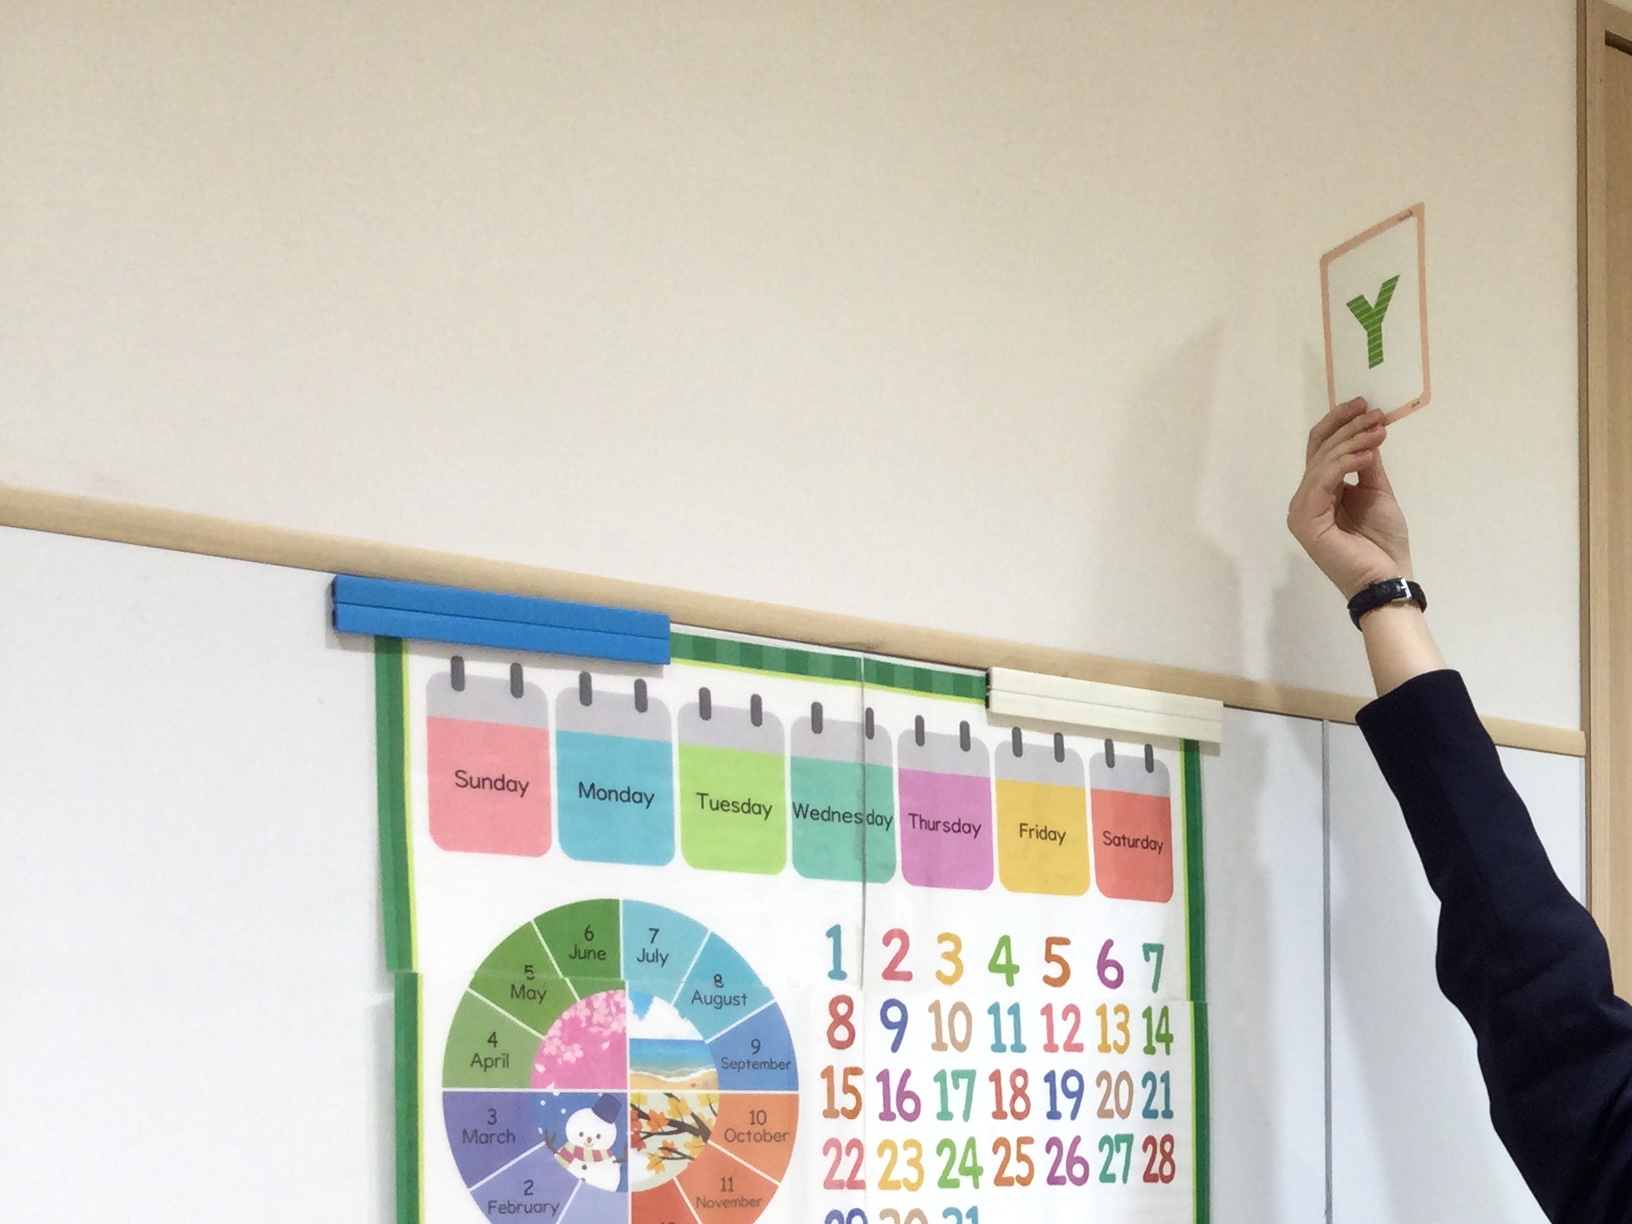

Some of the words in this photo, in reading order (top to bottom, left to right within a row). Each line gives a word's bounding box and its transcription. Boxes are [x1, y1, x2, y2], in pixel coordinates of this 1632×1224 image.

[1346, 274, 1400, 369] Y
[455, 770, 529, 796] Sunday
[578, 782, 655, 809] Monday
[696, 793, 773, 820] Tuesday
[793, 802, 893, 830] Wednesday
[909, 813, 981, 839] Thursday
[1019, 823, 1066, 846] Friday
[1102, 831, 1163, 856] Saturday
[584, 926, 594, 941] 6
[649, 928, 659, 944] 7
[569, 946, 606, 961] June
[637, 949, 669, 967] July
[826, 924, 848, 980] 1
[882, 928, 913, 981] 2
[935, 932, 964, 986] 3
[988, 935, 1019, 987] 4
[1042, 937, 1071, 987] 5
[1097, 939, 1124, 989] 6
[1142, 943, 1164, 993] 7
[524, 965, 535, 980] 5
[510, 985, 547, 1004] May
[691, 991, 748, 1008] August
[827, 994, 855, 1050] 8
[880, 998, 908, 1053] 9
[928, 1000, 972, 1052] 10
[987, 1002, 1027, 1053] 11
[1040, 1003, 1084, 1053] 12
[1095, 1003, 1130, 1054] 13
[1142, 1005, 1174, 1055] 14
[487, 1032, 498, 1048] 4
[750, 1039, 761, 1054] 9
[470, 1053, 509, 1069] April
[721, 1057, 791, 1071] September
[820, 1065, 864, 1120] 15
[876, 1068, 921, 1122] 16
[933, 1069, 977, 1122] 17
[989, 1068, 1031, 1120] 18
[1043, 1069, 1084, 1120] 19
[1096, 1070, 1134, 1119] 20
[1141, 1071, 1174, 1119] 21
[487, 1109, 497, 1125] 3
[749, 1110, 767, 1125] 10
[462, 1128, 515, 1144] March
[724, 1128, 789, 1143] October
[822, 1137, 866, 1190] 22
[877, 1139, 925, 1192] 23
[936, 1136, 983, 1189] 24
[992, 1136, 1035, 1187] 25
[1045, 1135, 1090, 1187] 26
[1098, 1133, 1134, 1184] 27
[1142, 1134, 1175, 1184] 28
[523, 1180, 534, 1196] 2
[721, 1177, 734, 1192] 11
[488, 1199, 560, 1218] February
[696, 1195, 762, 1209] November
